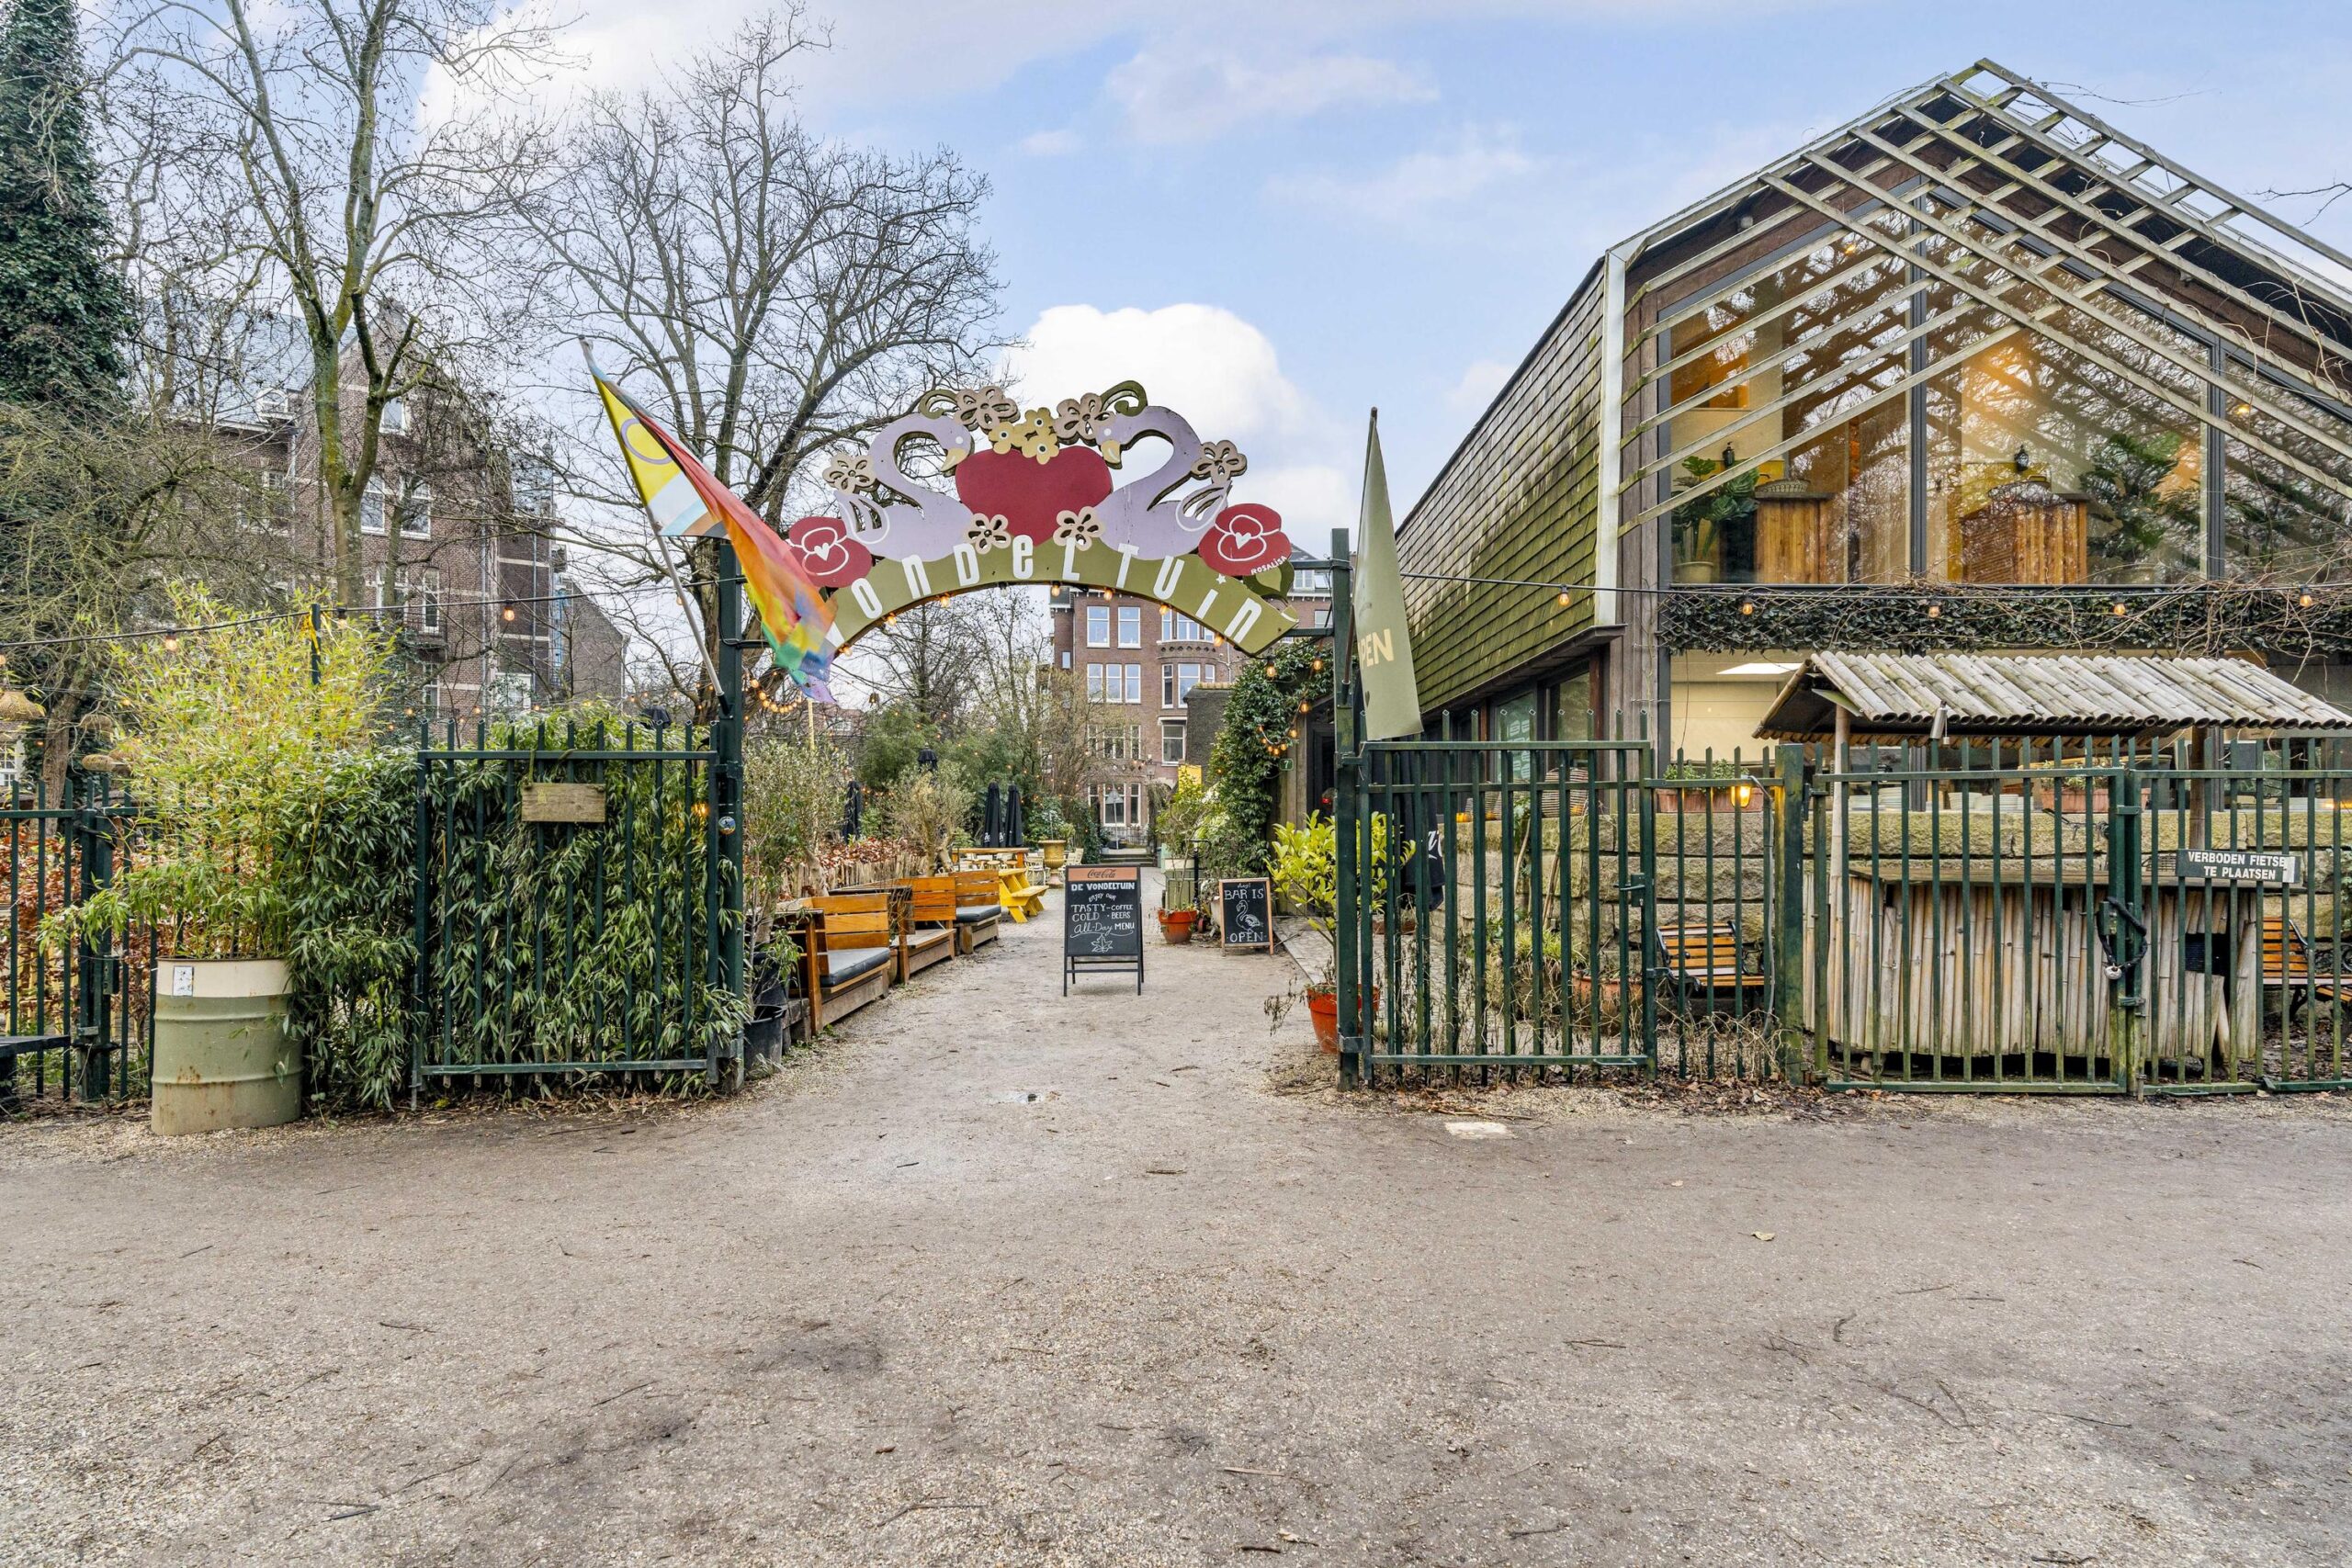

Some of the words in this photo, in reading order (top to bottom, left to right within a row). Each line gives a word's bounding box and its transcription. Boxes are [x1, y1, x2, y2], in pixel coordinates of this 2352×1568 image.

[1358, 628, 1394, 669] PEN
[1283, 760, 1289, 769] 7
[2188, 852, 2245, 865] VERBODEN
[2250, 854, 2286, 867] FIETSE
[2204, 865, 2217, 877] TE
[2222, 866, 2276, 880] PLAATSEN
[1086, 883, 1135, 891] VONDELTUIN
[1225, 889, 1248, 899] BAR
[1252, 888, 1264, 899] IS
[1072, 912, 1100, 922] COLD
[1112, 911, 1131, 919] BEERS
[1229, 932, 1263, 942] OPEN
